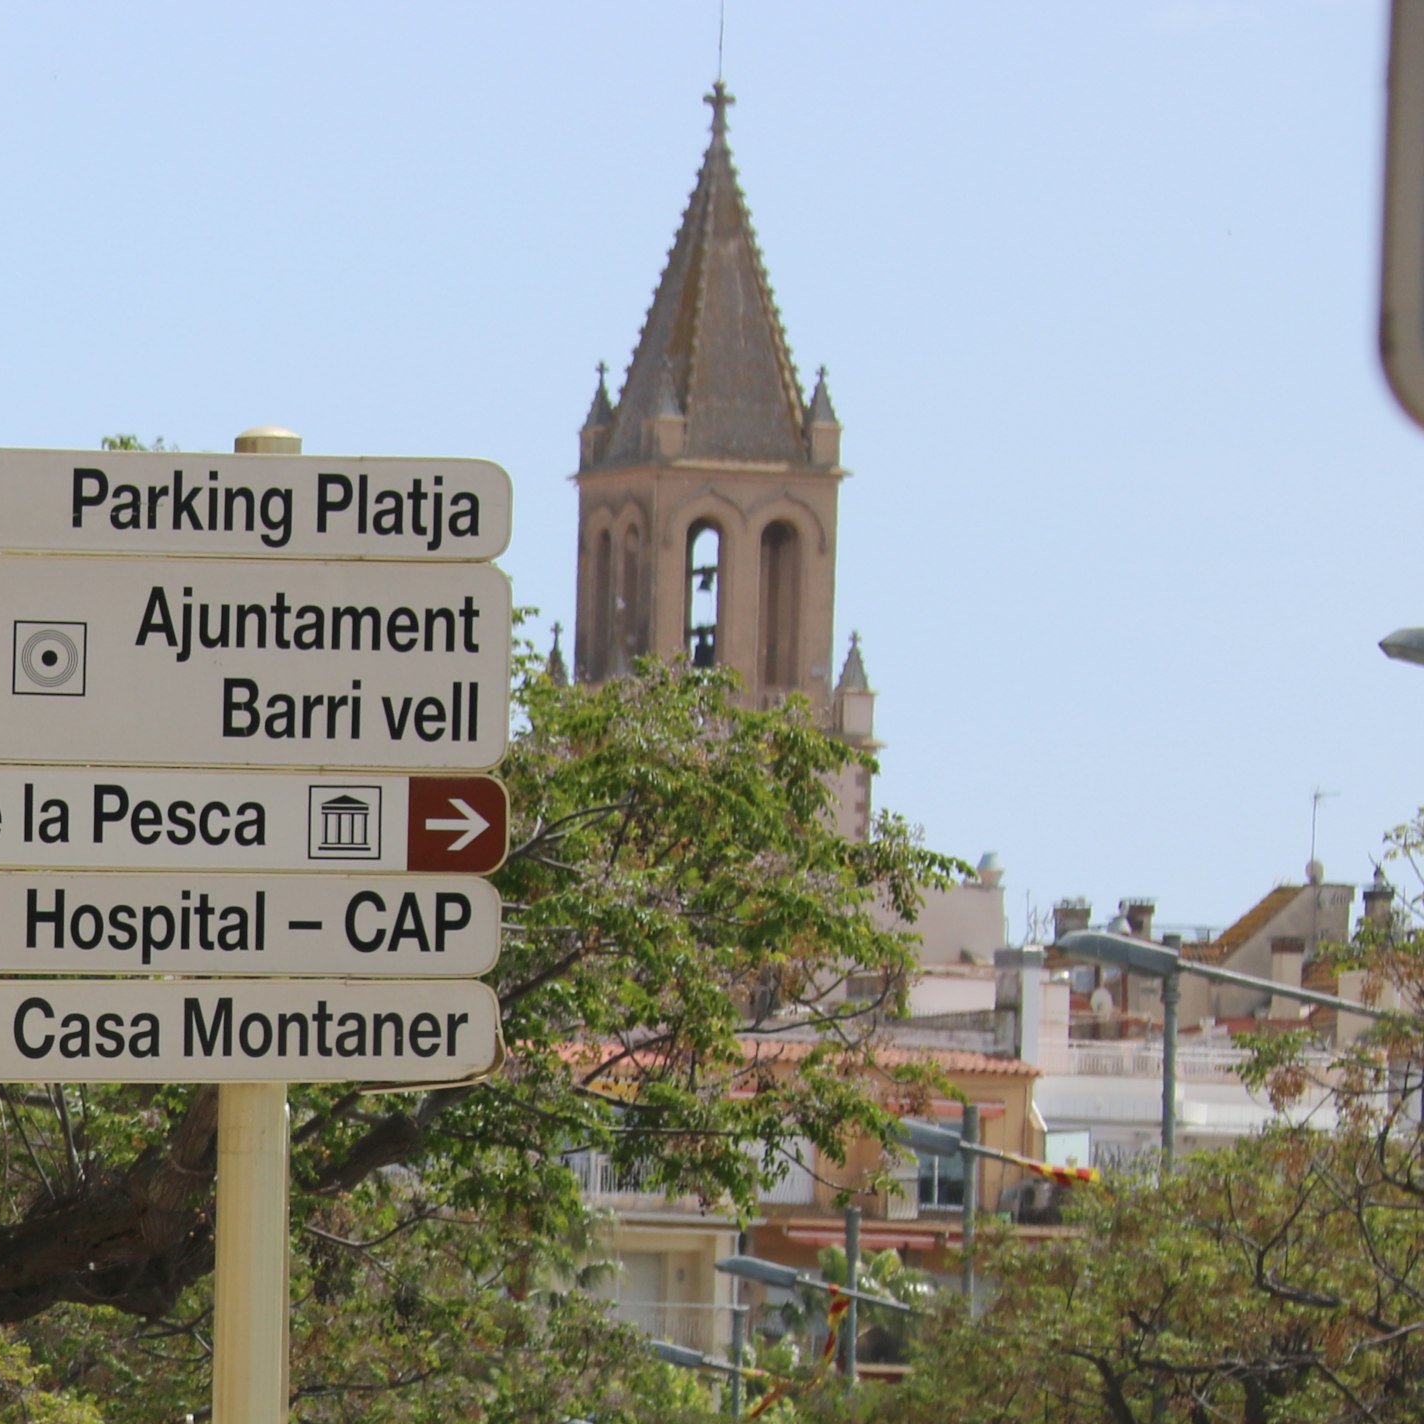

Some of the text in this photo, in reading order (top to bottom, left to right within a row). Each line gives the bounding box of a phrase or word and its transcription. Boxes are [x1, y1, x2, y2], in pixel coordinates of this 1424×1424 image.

[71, 467, 294, 549] Parking
[316, 473, 480, 552] Platja
[134, 586, 480, 663] Ajuntament
[222, 677, 479, 743] Barri vell
[23, 783, 71, 844] la
[92, 784, 267, 847] Pesca
[26, 888, 266, 965] Hospital
[344, 890, 472, 953] CAP
[13, 996, 469, 1060] Casa Montaner
